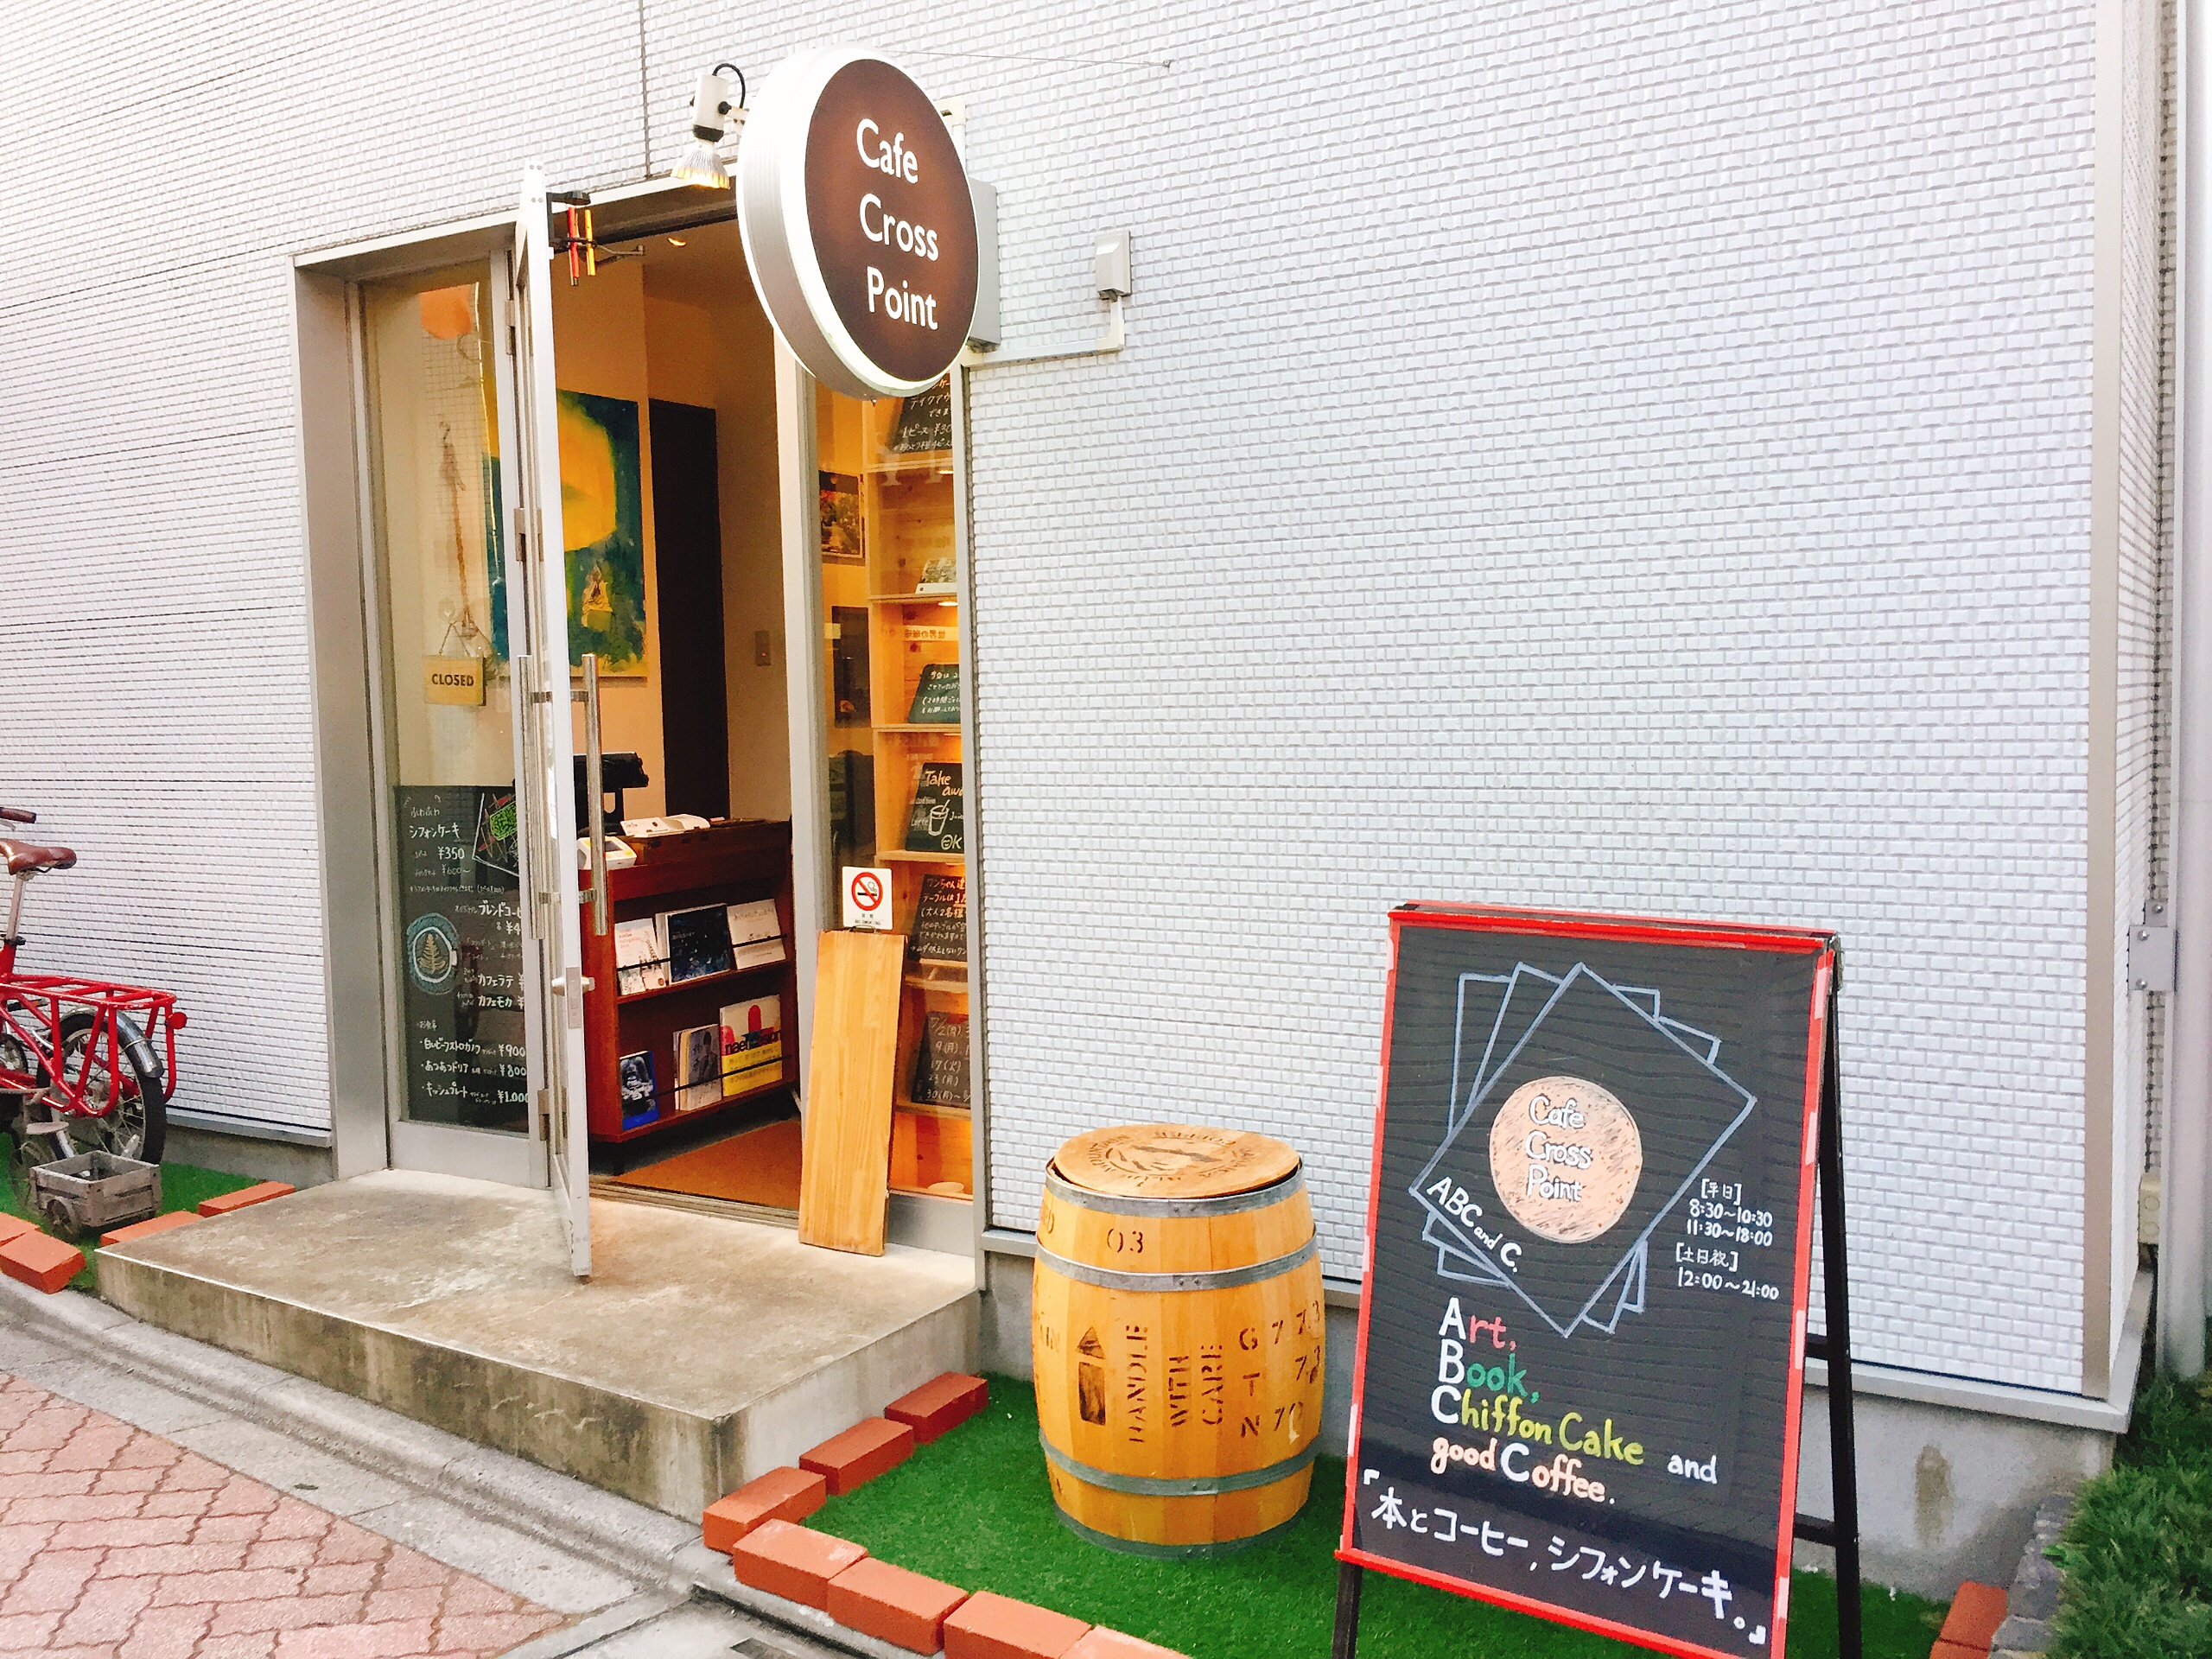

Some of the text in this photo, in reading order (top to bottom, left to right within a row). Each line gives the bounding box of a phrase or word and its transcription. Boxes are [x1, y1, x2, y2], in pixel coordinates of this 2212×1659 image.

[856, 118, 918, 184] Cafe
[859, 193, 939, 261] Cross
[867, 266, 938, 330] Point
[431, 674, 474, 686] CLOSED
[924, 770, 952, 787] Take
[409, 822, 461, 839] シフォンケーキ
[941, 834, 963, 850] OK
[437, 846, 466, 860] ¥350
[478, 973, 514, 988] カフェラテ
[478, 995, 513, 1007] カフェモカ
[499, 1044, 526, 1058] ¥900
[499, 1064, 527, 1077] ¥800
[1529, 1095, 1586, 1131] Cafe
[1525, 1130, 1592, 1170] Cross
[1527, 1164, 1583, 1202] Point
[1426, 1176, 1484, 1228] ABC
[1473, 1226, 1504, 1250] and
[1106, 1228, 1144, 1254] 03
[1239, 1327, 1258, 1351] G
[1438, 1297, 1517, 1350] Art,
[1125, 1325, 1148, 1443] HANDLE
[1201, 1344, 1224, 1426] CARE
[1243, 1372, 1261, 1396] T
[1438, 1338, 1540, 1403] Book,
[1168, 1355, 1191, 1427] WITH
[1241, 1414, 1261, 1438] N
[1431, 1385, 1718, 1485] Chiffon Cake and
[1430, 1436, 1616, 1505] good Coffee.
